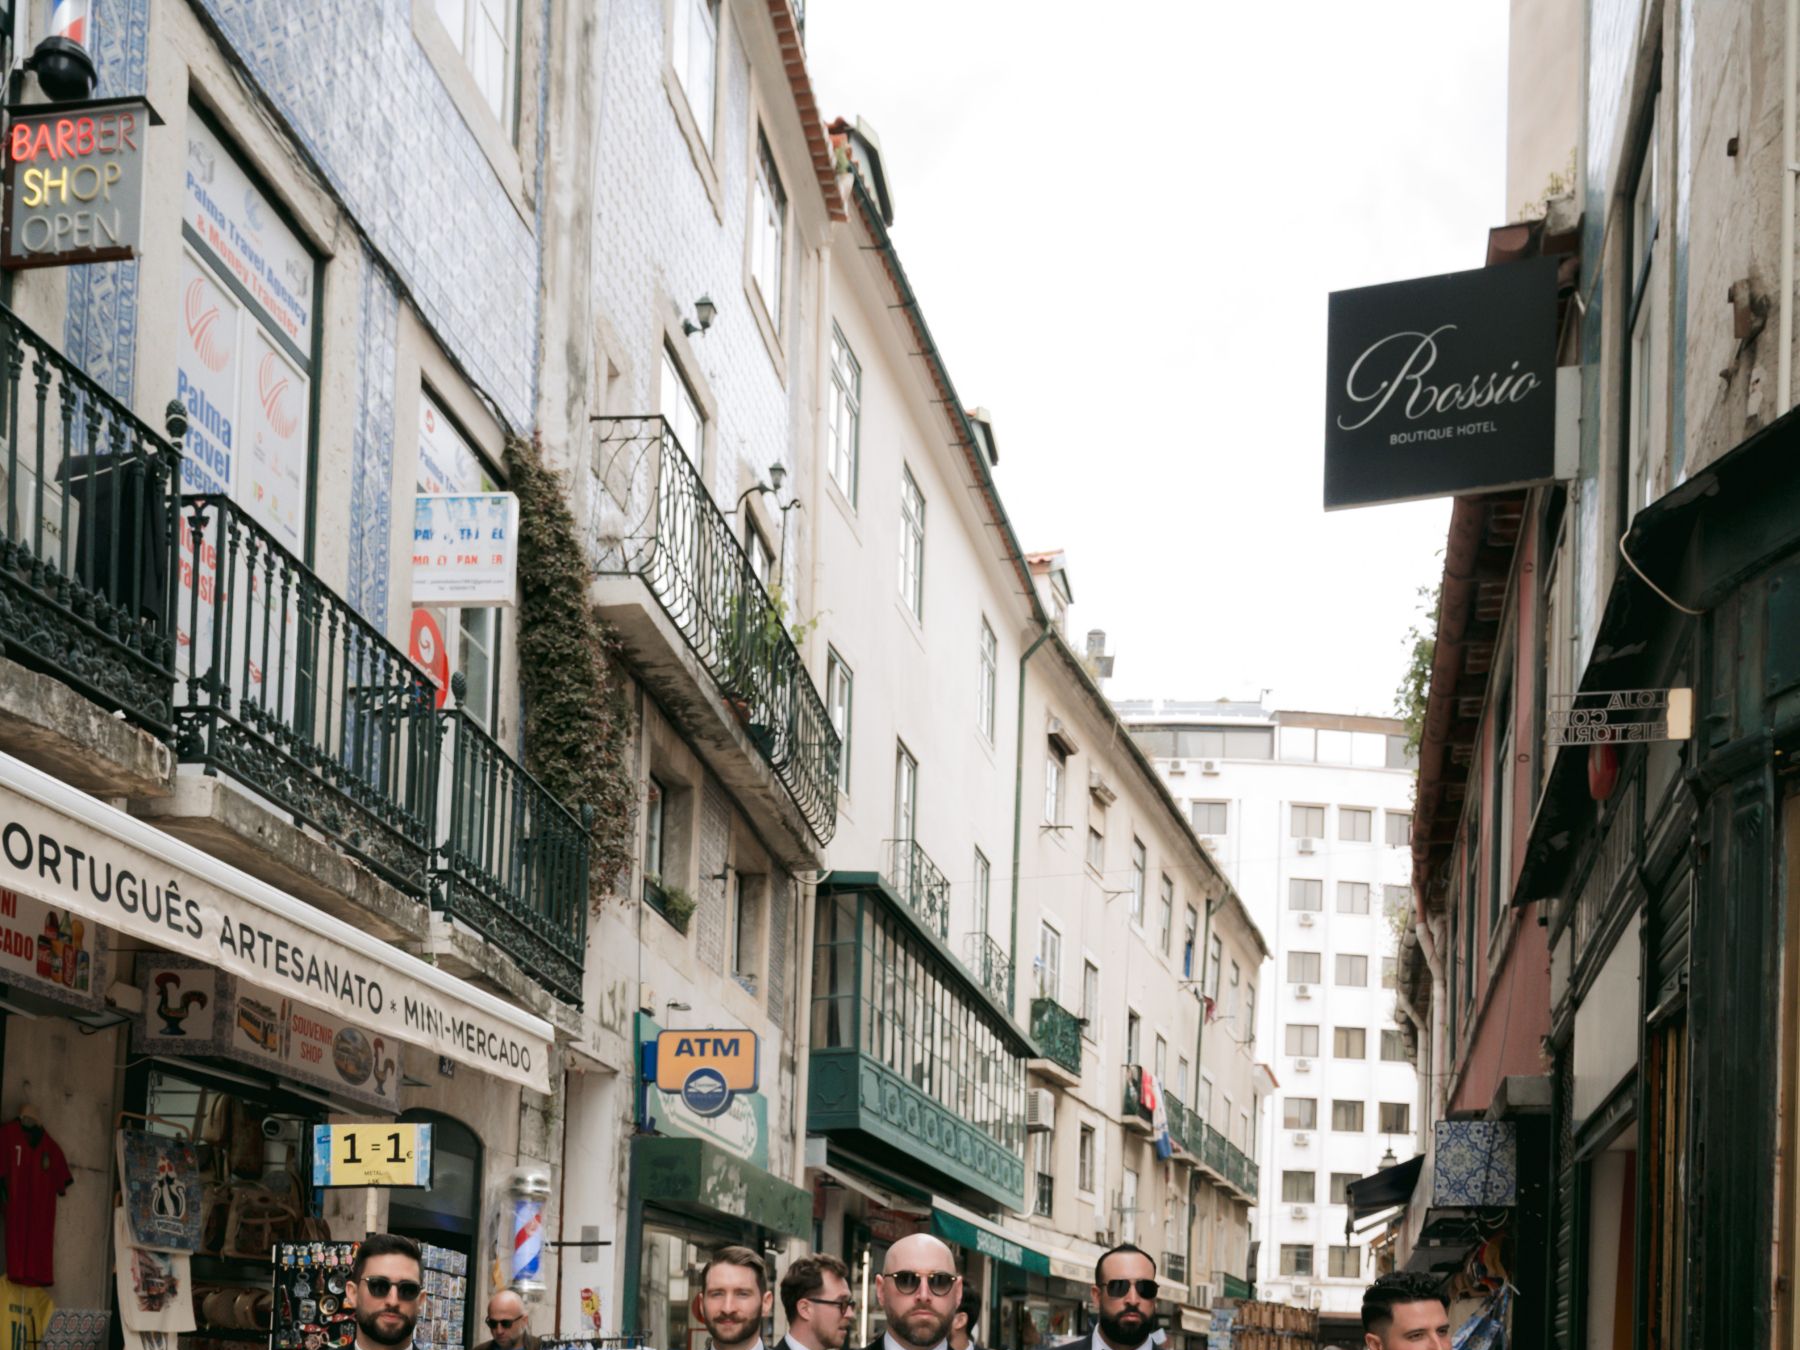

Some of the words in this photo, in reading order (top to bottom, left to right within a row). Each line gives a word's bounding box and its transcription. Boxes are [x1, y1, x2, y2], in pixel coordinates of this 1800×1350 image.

[11, 112, 137, 162] BARBER
[22, 161, 122, 207] SHOP
[21, 208, 121, 253] OPEN
[186, 170, 226, 231] Palma
[229, 219, 265, 277] Travel
[266, 265, 308, 327] Agency
[208, 226, 251, 284] Money
[250, 275, 300, 339] Transfer
[1336, 324, 1542, 431] Rossio
[177, 367, 232, 450] Palma
[184, 424, 231, 484] ravel
[1389, 426, 1454, 446] BOUTIQUE
[1456, 421, 1498, 437] HOTEL
[219, 914, 384, 1016] ARTESANATO
[403, 995, 532, 1074] MINI-MERCADO
[292, 1013, 334, 1046] SOUVENIR
[301, 1041, 323, 1064] SHOP
[674, 1037, 740, 1058] ATM
[343, 1133, 362, 1163] 1
